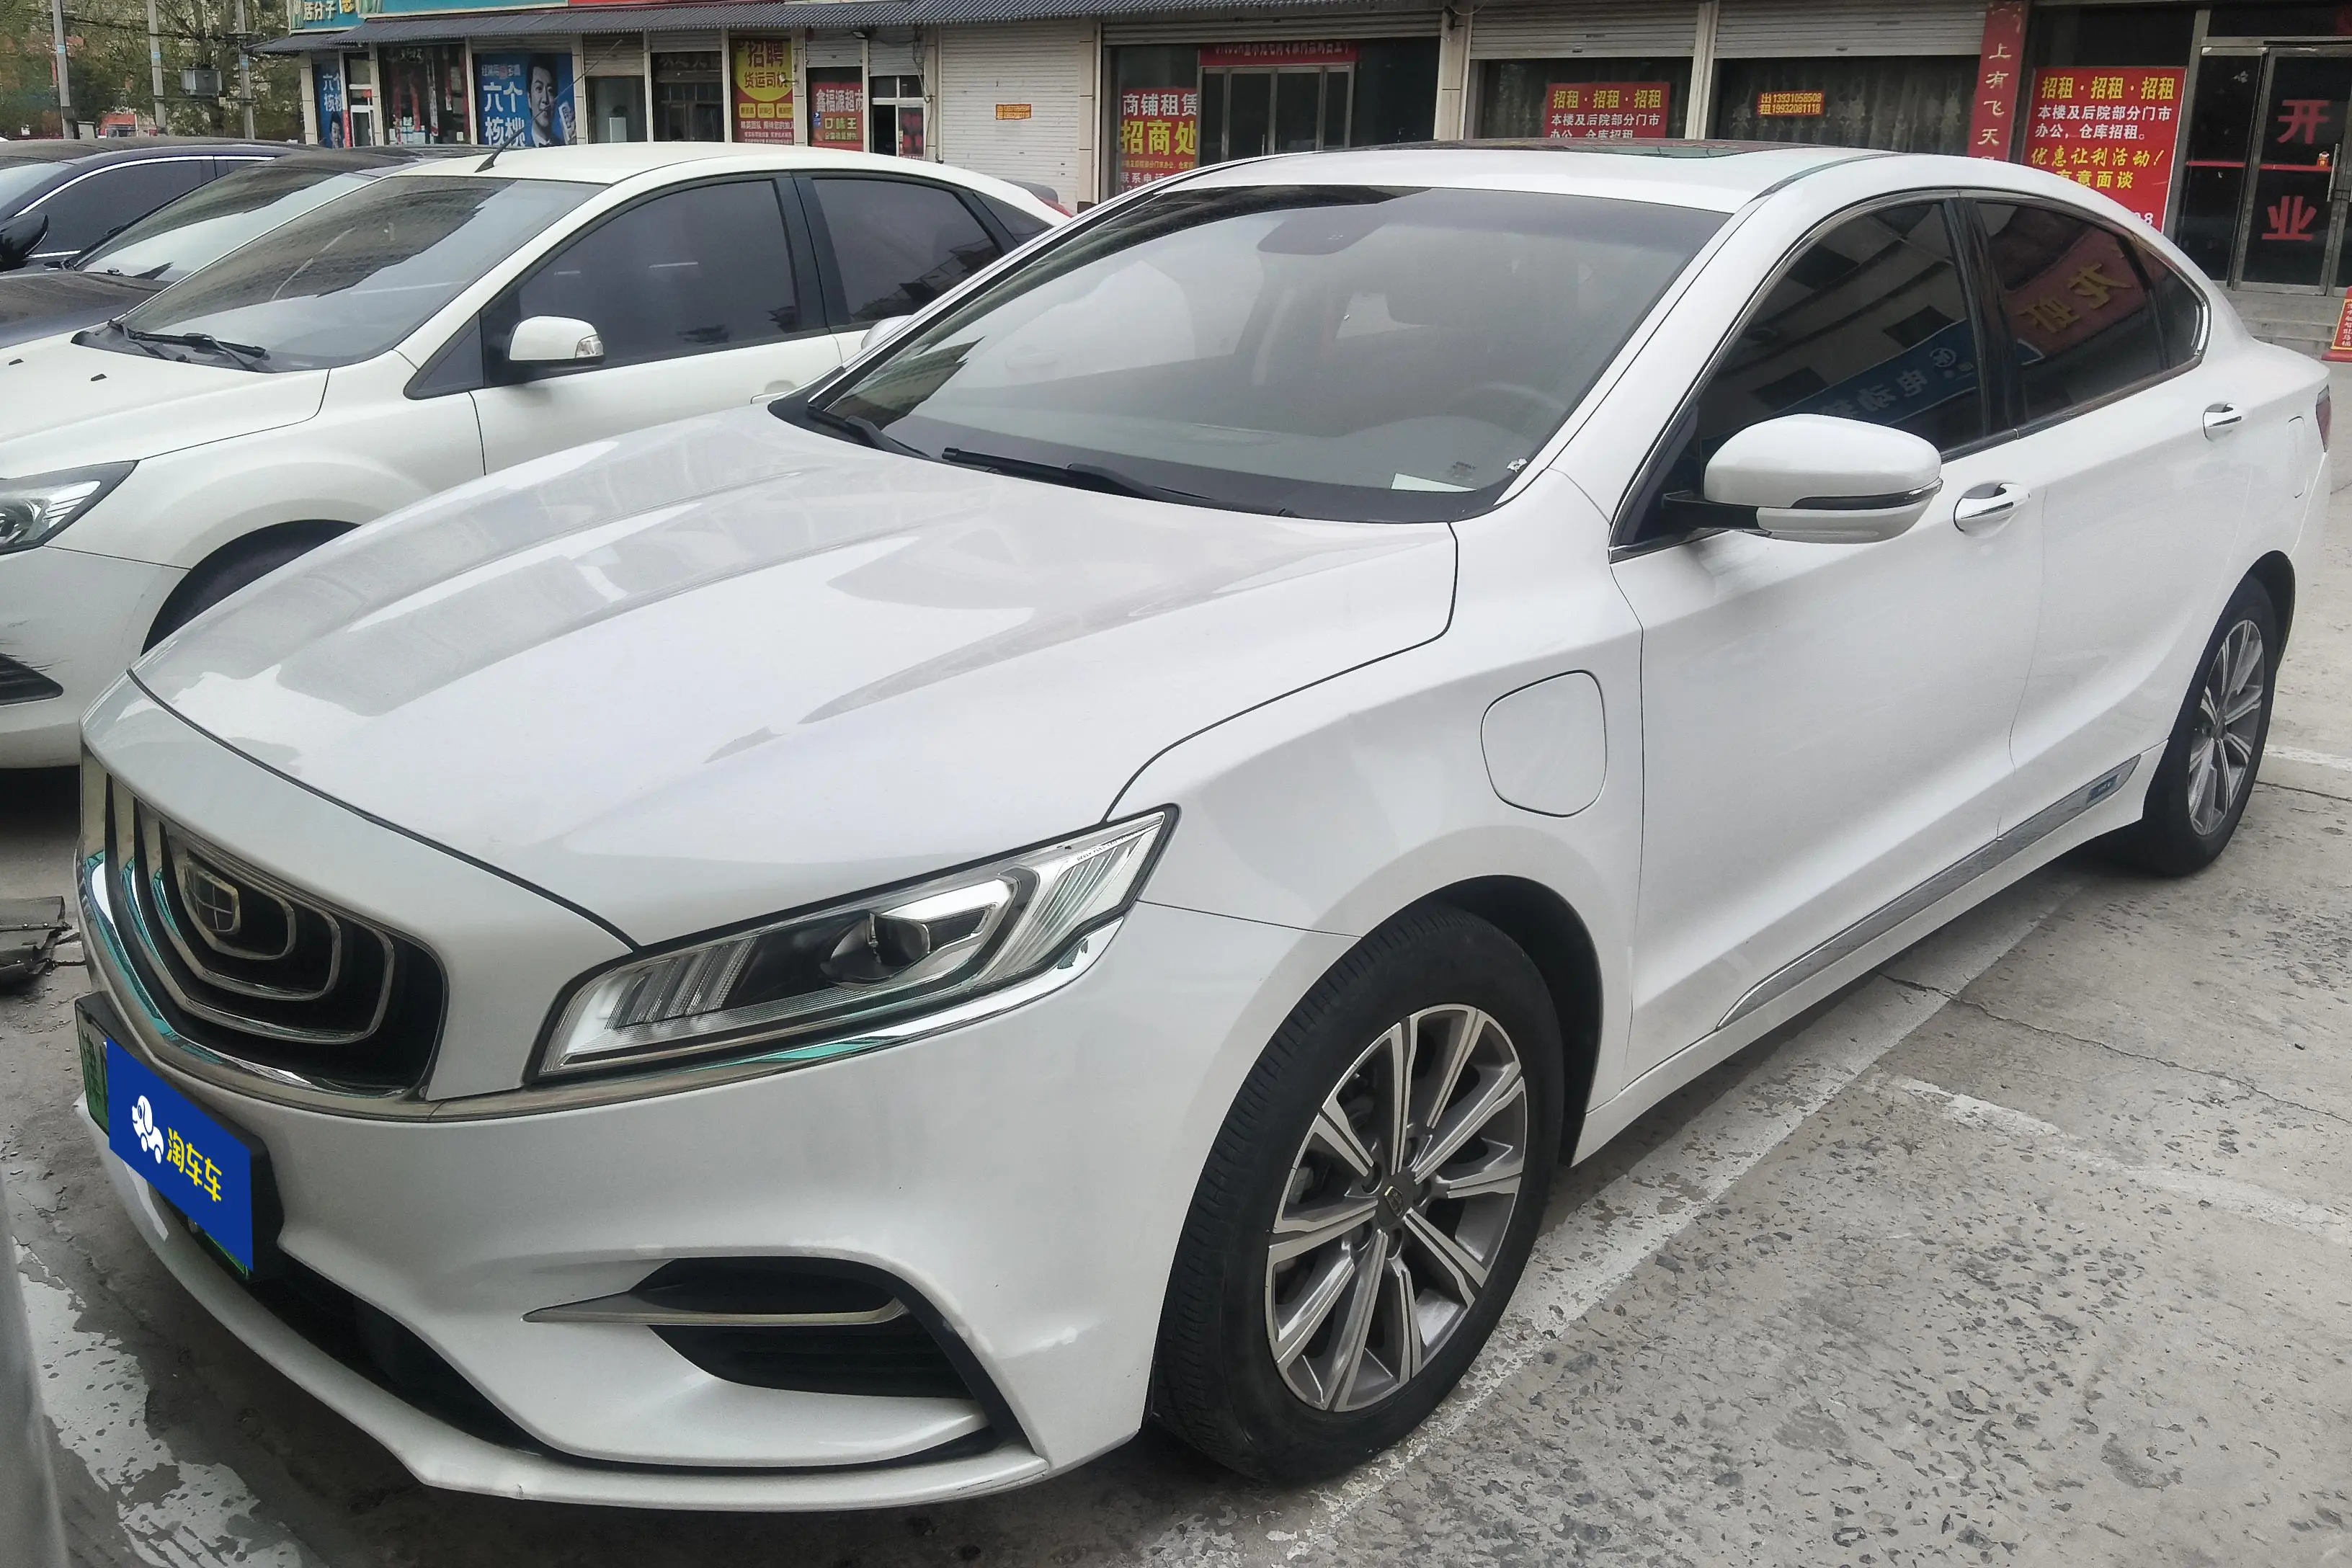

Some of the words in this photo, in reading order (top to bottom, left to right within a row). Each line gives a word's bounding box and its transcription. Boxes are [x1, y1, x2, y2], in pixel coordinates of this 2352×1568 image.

[747, 40, 784, 68] 招聘
[483, 81, 523, 113] 六个
[816, 89, 863, 112] 鑫福源超市
[1122, 93, 1198, 117] 商铺租赁
[1977, 43, 2012, 160] 上有飞天
[1551, 113, 1660, 126] 本楼及后院部分门市
[2038, 104, 2172, 121] 本楼及后院部分门市
[1121, 119, 1196, 156] 招商处
